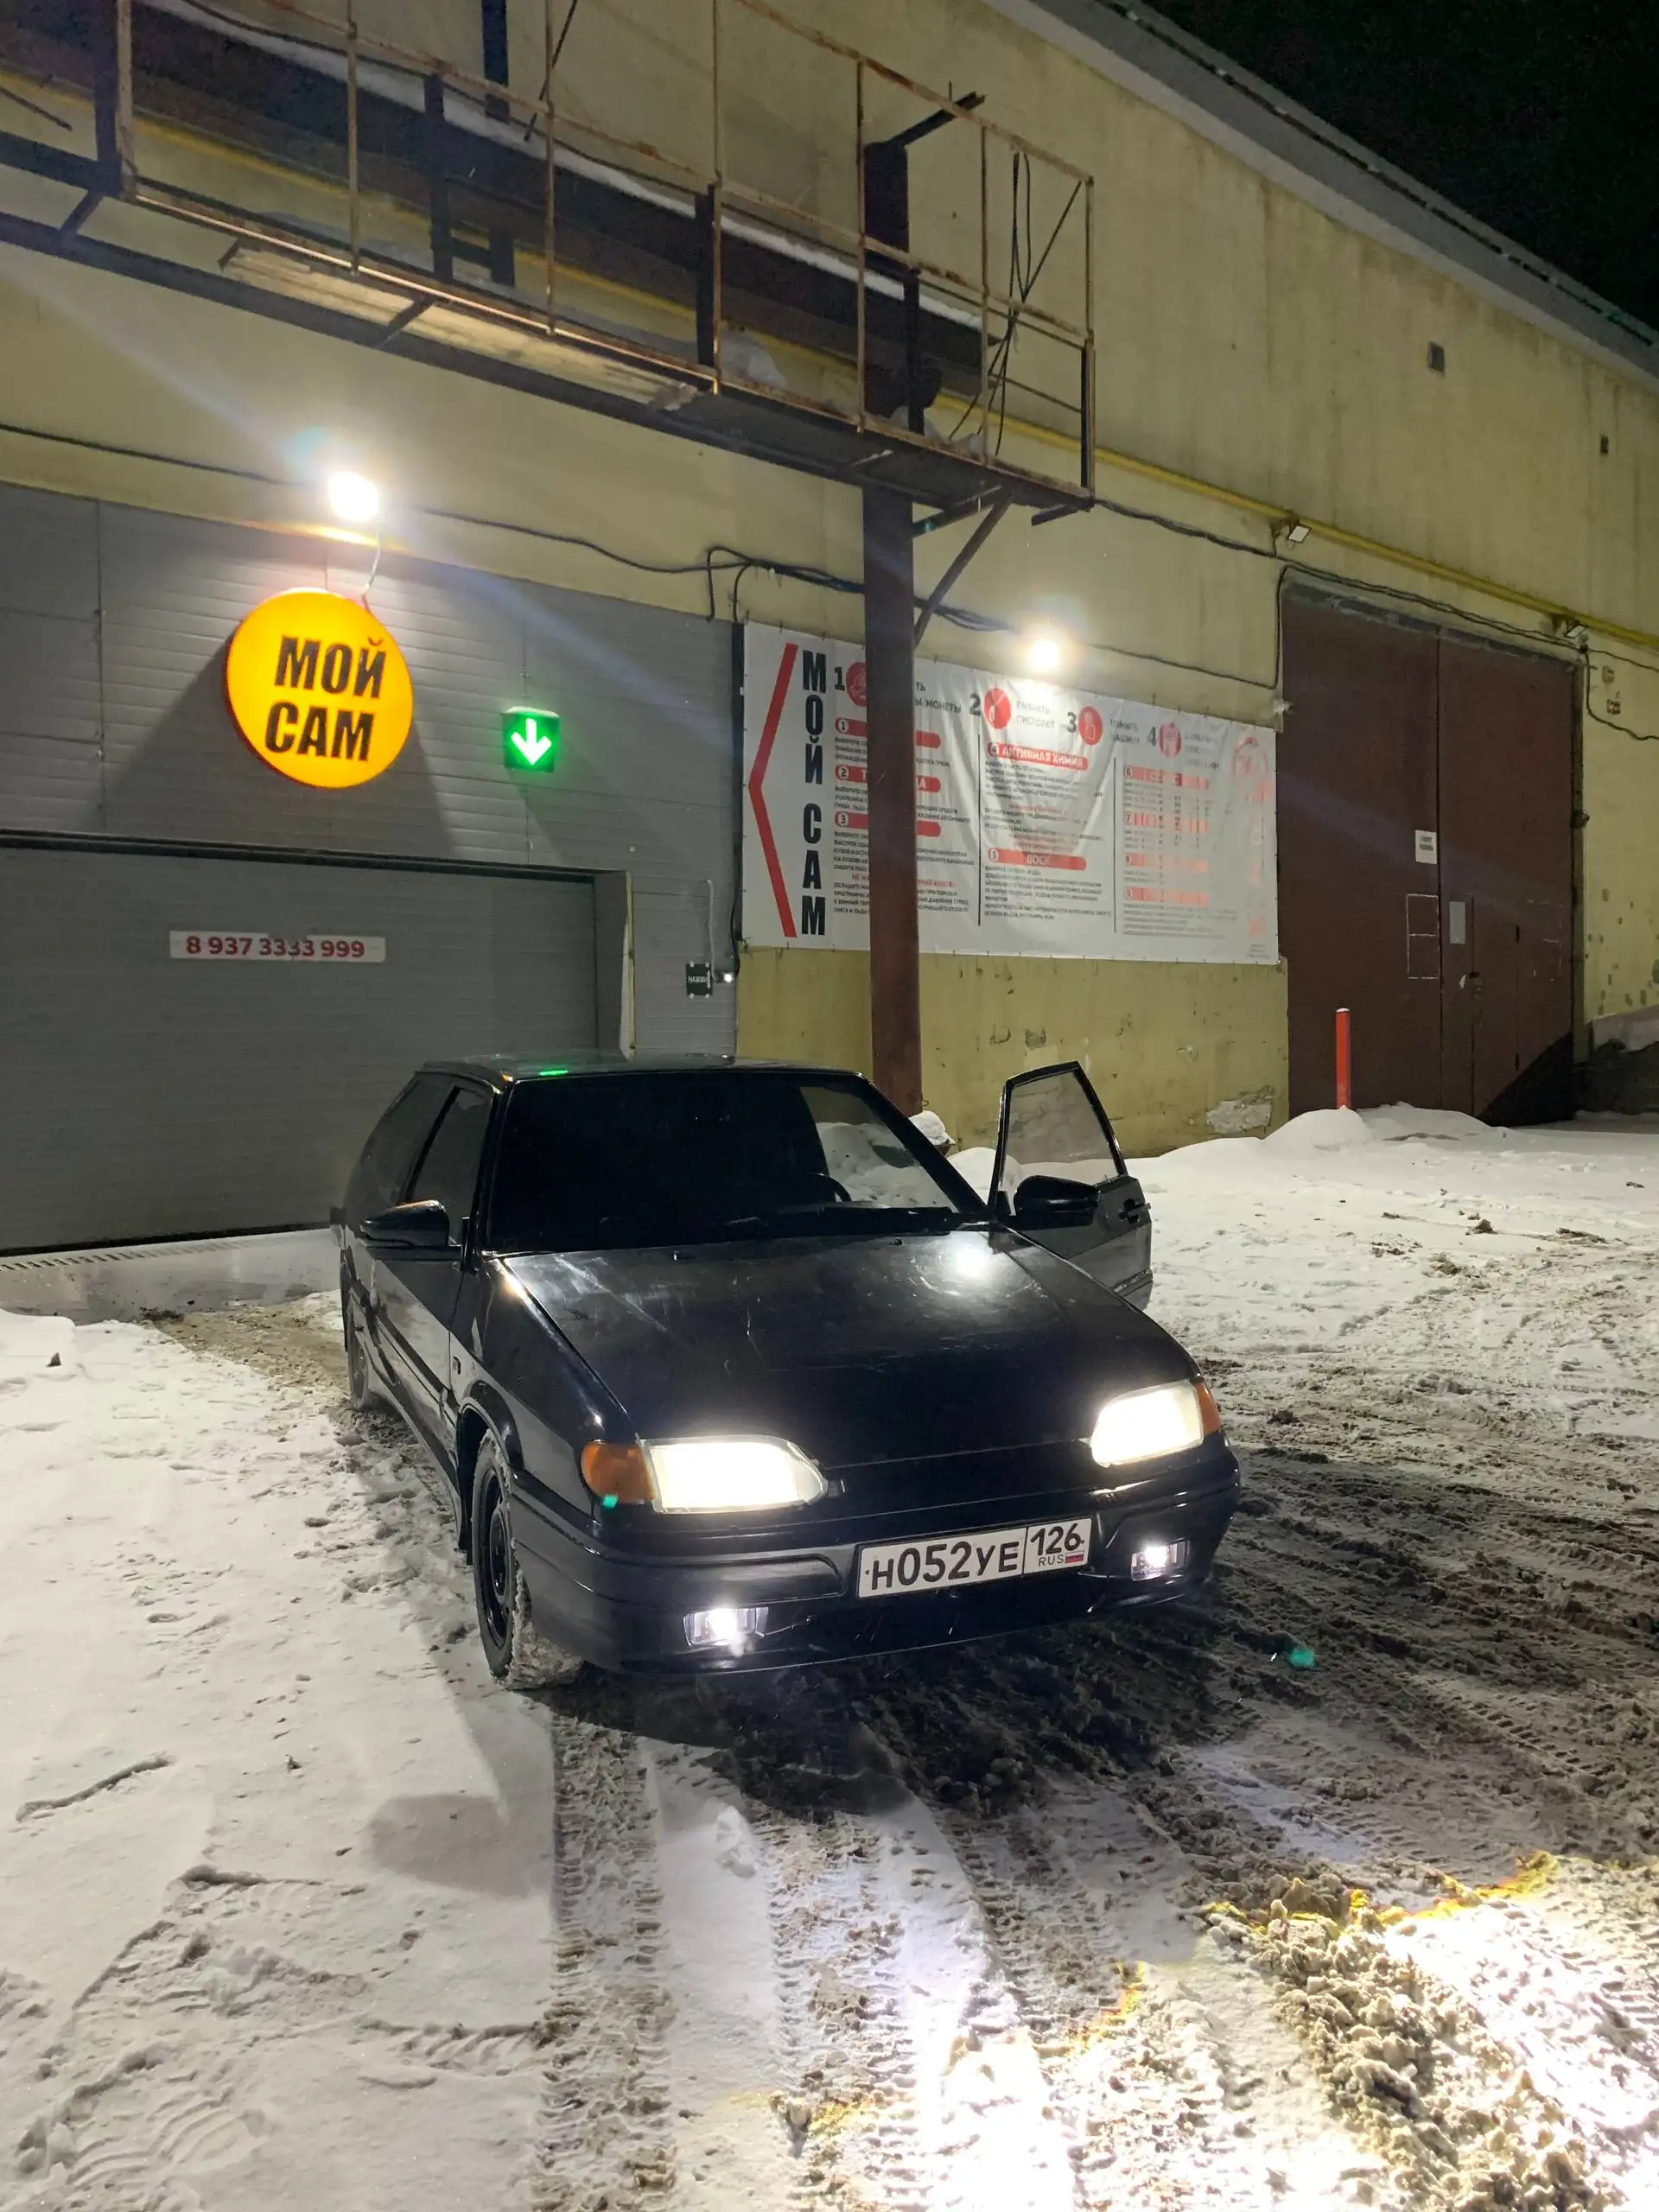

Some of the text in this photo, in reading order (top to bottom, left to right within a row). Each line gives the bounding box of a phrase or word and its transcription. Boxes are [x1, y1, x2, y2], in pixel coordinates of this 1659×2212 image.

[274, 634, 386, 698] МОЙ
[834, 666, 845, 691] 1
[969, 693, 982, 716] 2
[265, 701, 375, 761] САМ
[1066, 711, 1077, 734] 3
[1147, 727, 1157, 747] 4
[802, 650, 826, 936] МОЙ САМ
[186, 936, 201, 955] 8
[208, 937, 253, 956] 937
[321, 940, 365, 958] 999
[871, 1522, 1083, 1591] Н052УЕ 126
[1039, 1554, 1064, 1567] RUS
